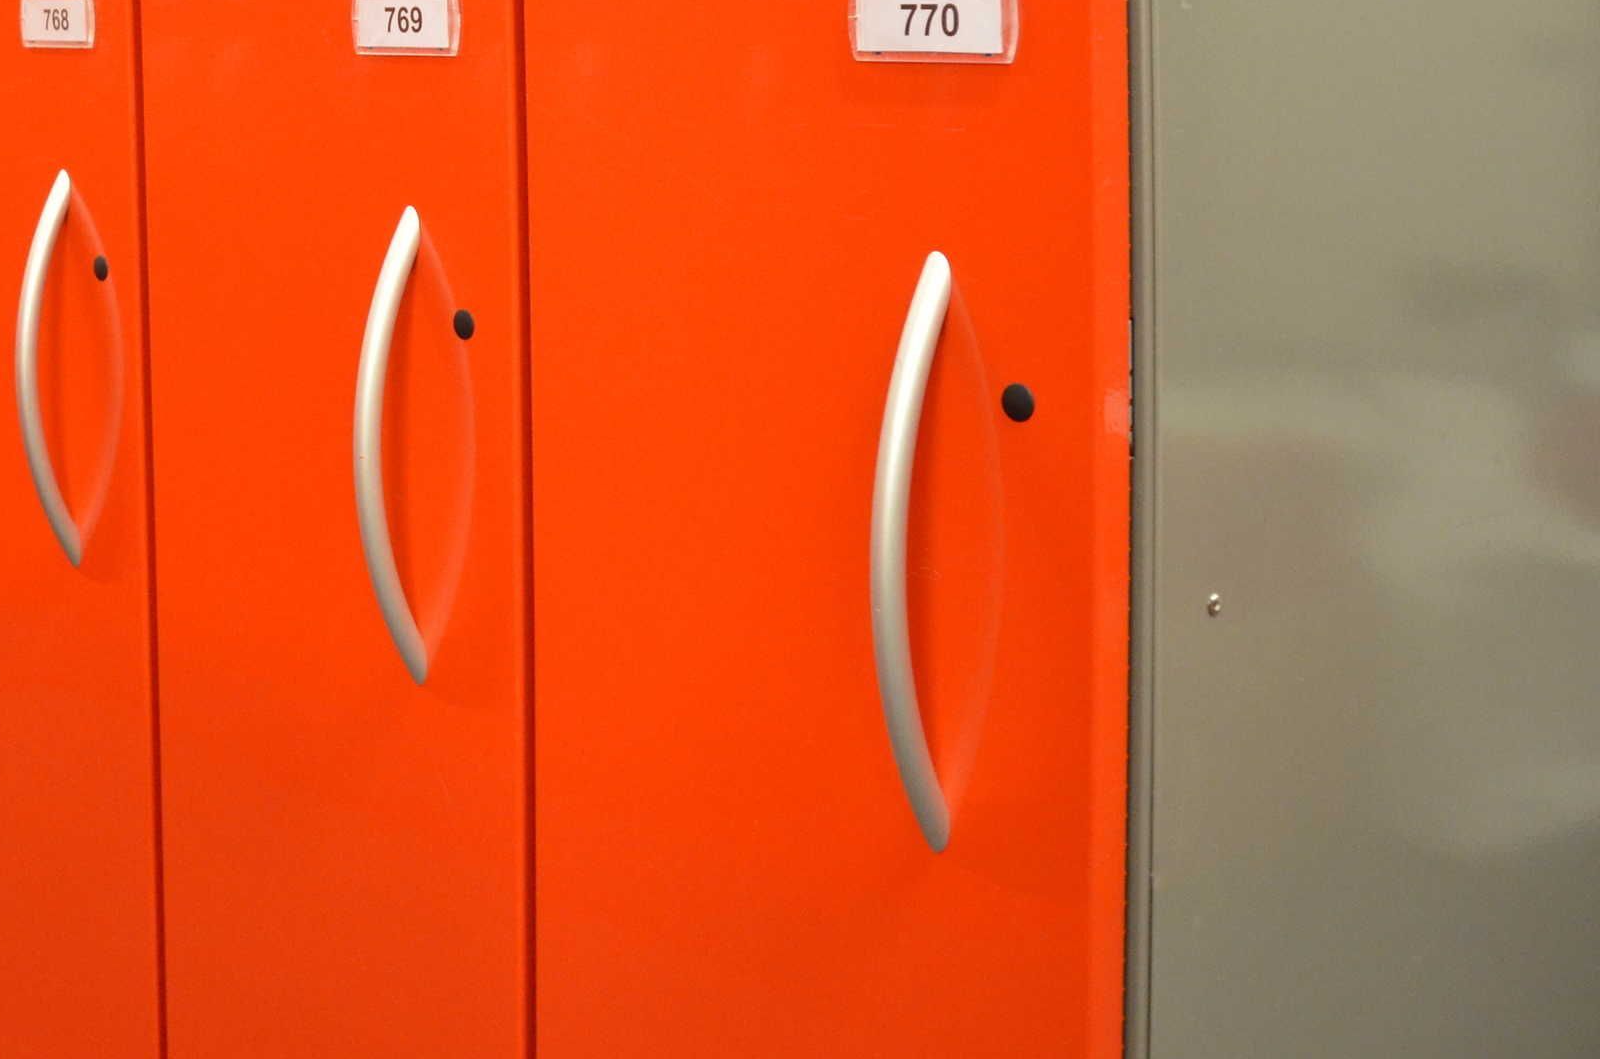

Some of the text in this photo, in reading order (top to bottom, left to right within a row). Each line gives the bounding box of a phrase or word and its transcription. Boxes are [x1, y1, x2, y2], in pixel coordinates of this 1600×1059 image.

[43, 8, 69, 32] 768
[383, 6, 423, 35] 769
[899, 2, 960, 38] 770
